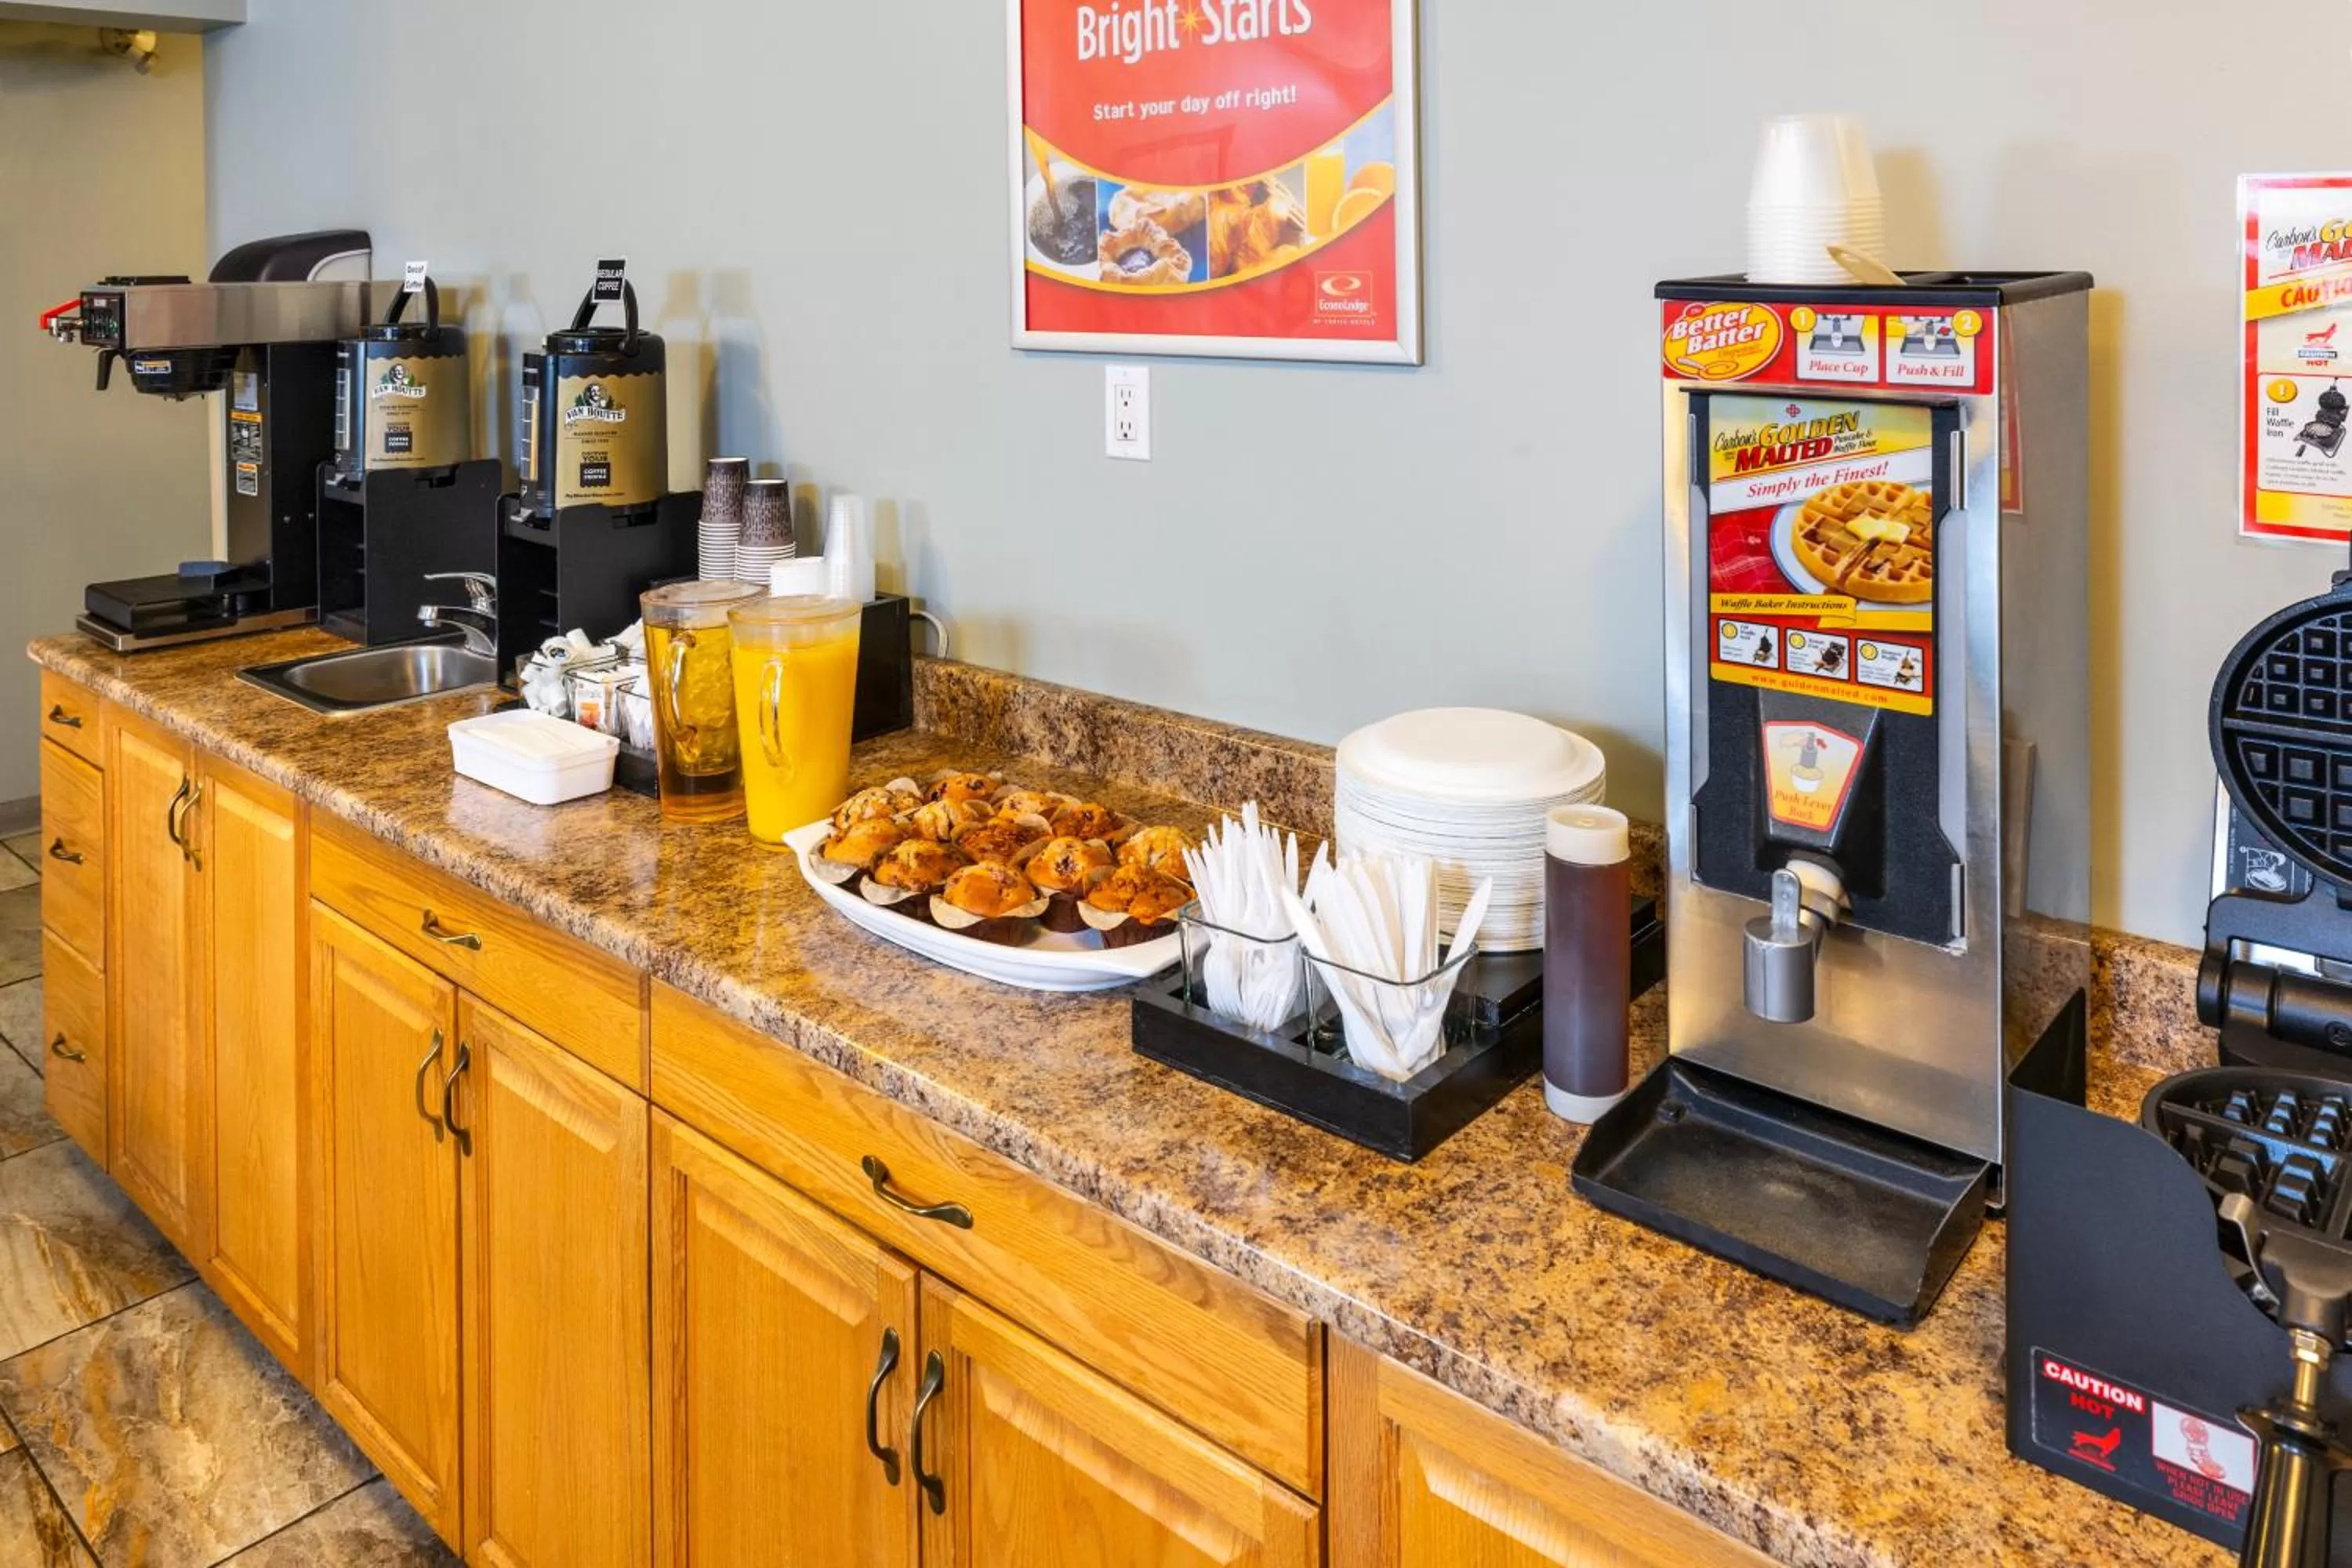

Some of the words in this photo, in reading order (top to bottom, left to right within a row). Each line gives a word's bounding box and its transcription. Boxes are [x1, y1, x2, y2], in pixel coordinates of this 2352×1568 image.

[1077, 0, 1180, 64] Bright
[1201, 0, 1312, 45] Starts
[1094, 102, 1134, 120] Start
[1140, 100, 1176, 121] your
[1181, 95, 1210, 114] day
[1217, 91, 1240, 110] off
[1246, 85, 1297, 110] right!
[1671, 306, 1753, 341] Better
[1799, 310, 1806, 326] 1
[1962, 315, 1972, 330] 2
[1686, 321, 1766, 355] Batter
[1809, 360, 1840, 372] Place
[1843, 361, 1868, 375] Cup
[1897, 364, 1928, 376] Push
[1929, 367, 1940, 376] &
[1942, 365, 1965, 378] Fill
[2267, 408, 2279, 416] Fill
[2267, 418, 2295, 428] Waffle
[1759, 410, 1860, 448] GOLDEN
[2267, 429, 2284, 437] Iron
[1735, 437, 1833, 472] MALTED
[1747, 477, 1801, 499] Simply
[1805, 471, 1829, 488] the
[1834, 461, 1889, 484] Finest!
[1720, 598, 1751, 609] Waffle
[1754, 598, 1784, 610] Baker
[1785, 598, 1849, 611] Instructions
[1774, 789, 1800, 804] Push
[1802, 796, 1833, 812] Lever
[2044, 1361, 2143, 1412] CAUTION
[2071, 1392, 2114, 1420] HOT
